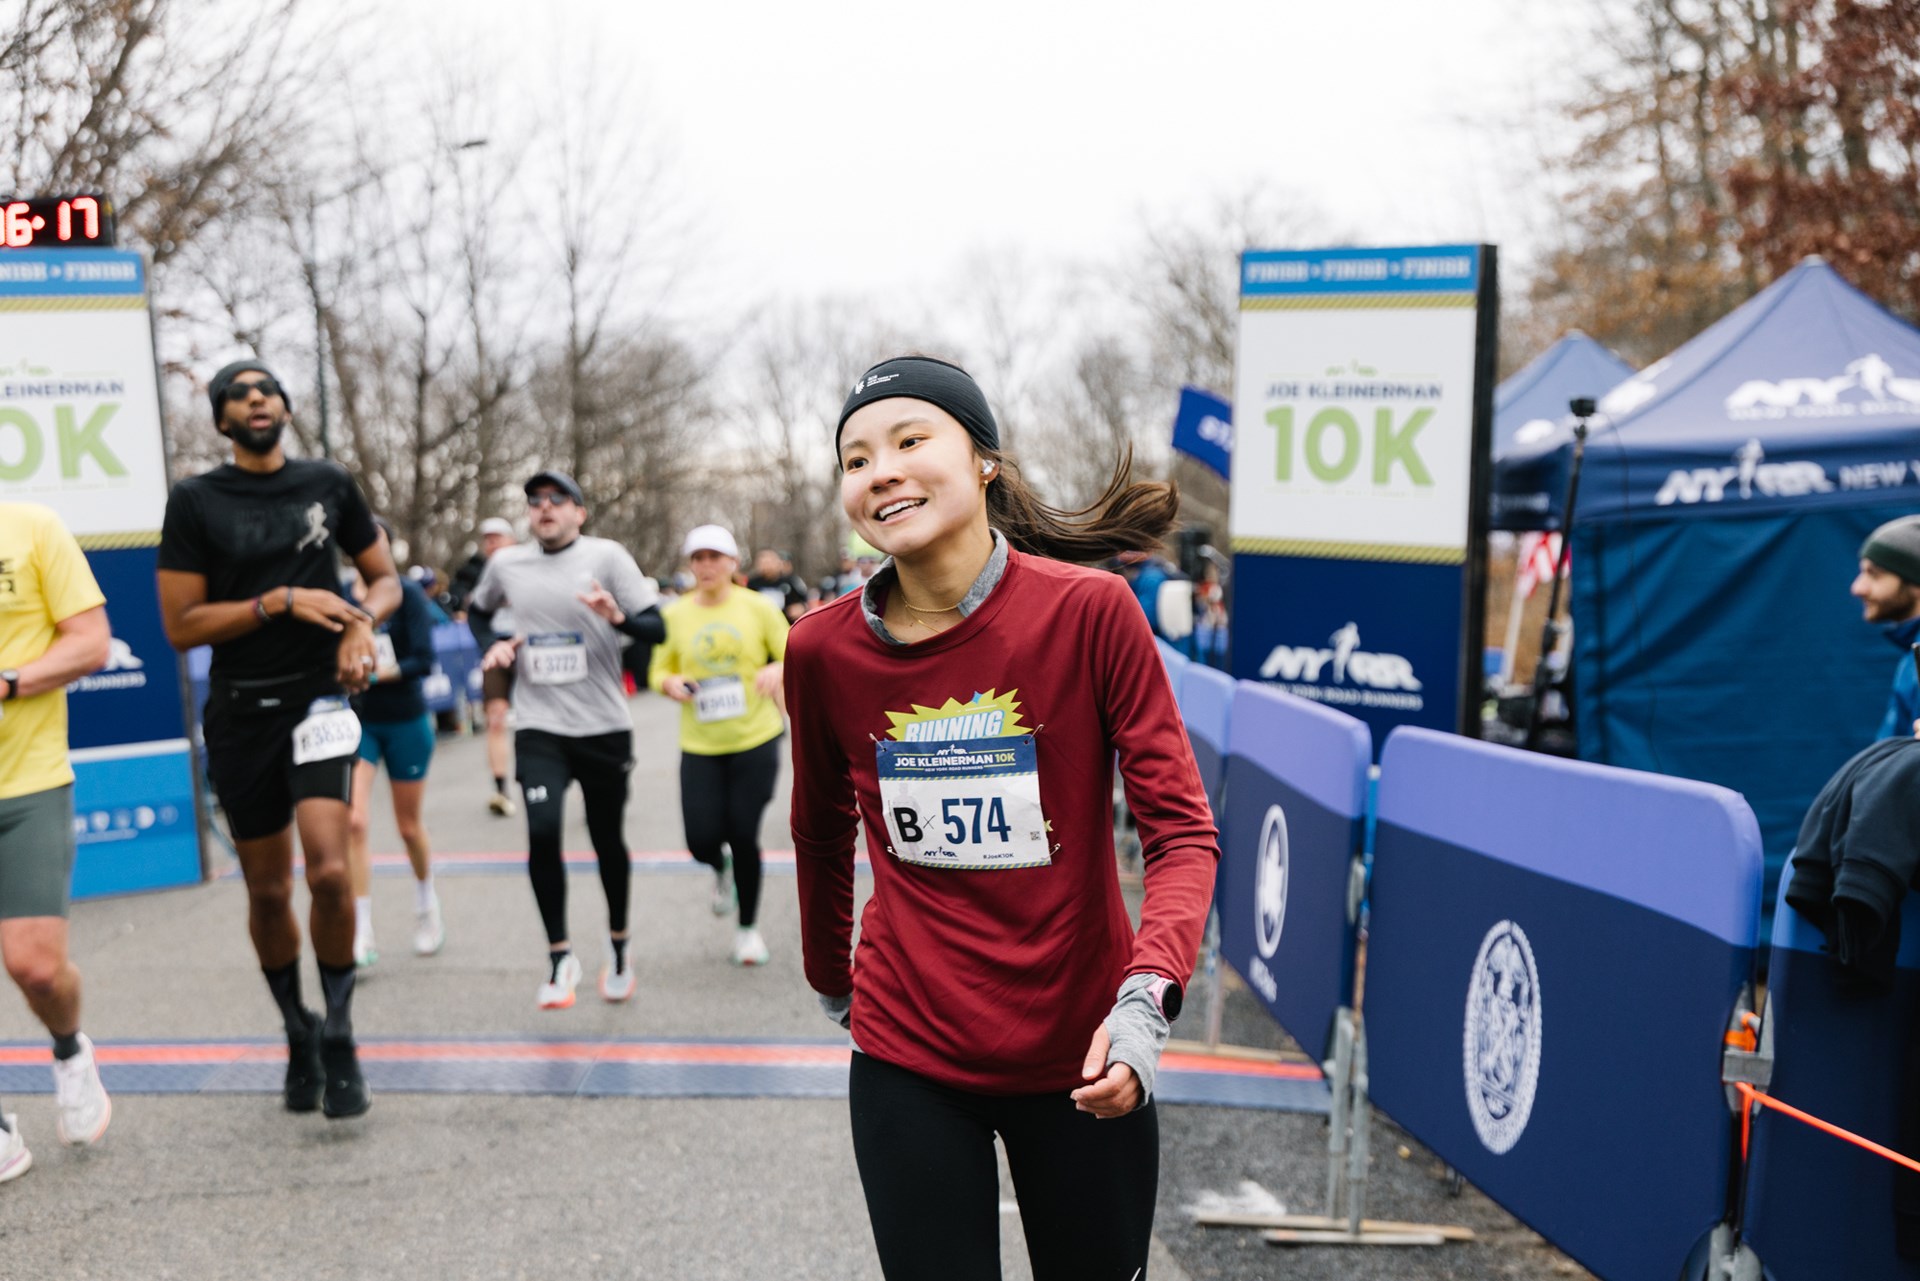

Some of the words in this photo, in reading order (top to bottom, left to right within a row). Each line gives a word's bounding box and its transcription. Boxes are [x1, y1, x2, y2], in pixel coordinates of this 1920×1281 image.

[1266, 383, 1301, 399] JOE
[1308, 383, 1442, 400] KLEINERMAN
[1264, 405, 1436, 487] 10K
[1839, 461, 1907, 491] NEW
[904, 710, 1006, 742] RUNNING
[895, 757, 916, 767] JOE
[918, 754, 993, 767] KLEINERMAN
[995, 753, 1016, 763] 10K
[893, 807, 923, 843] B
[942, 797, 1011, 844] 574
